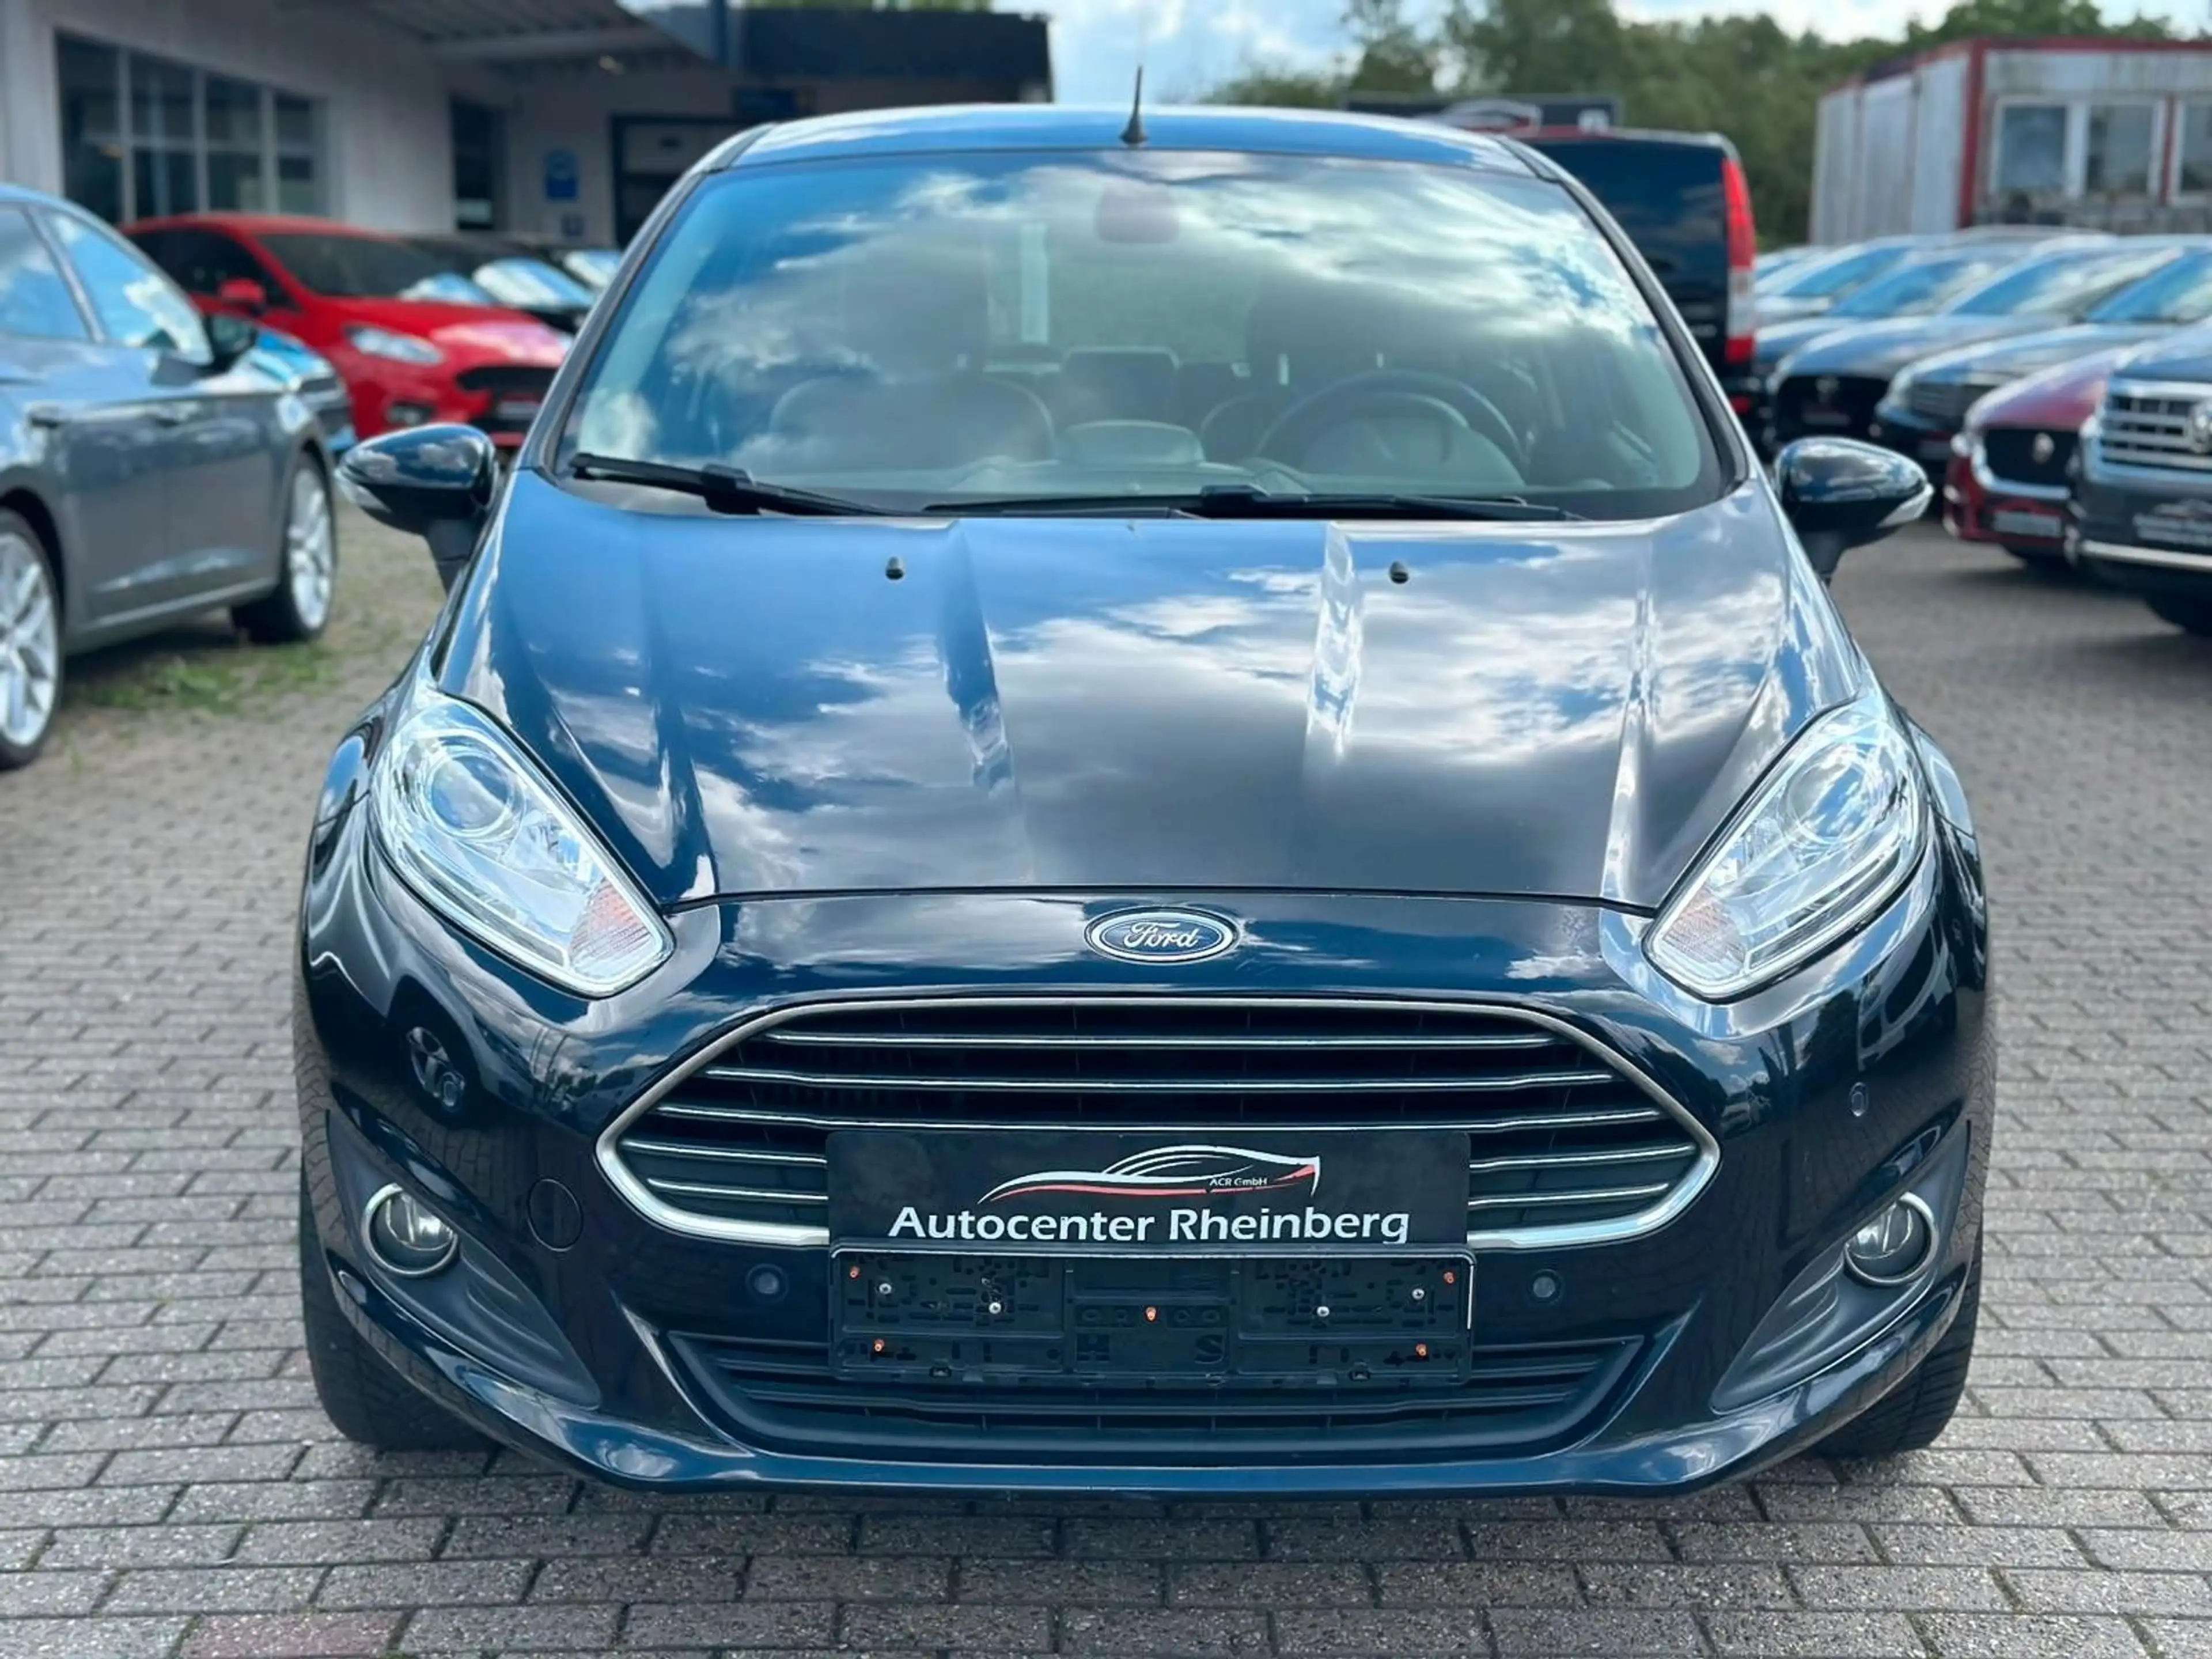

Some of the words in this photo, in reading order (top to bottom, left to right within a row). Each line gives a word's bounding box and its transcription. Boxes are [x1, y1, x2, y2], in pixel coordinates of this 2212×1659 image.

[1123, 922, 1200, 948] Ford
[1210, 1177, 1232, 1186] ACR
[1234, 1177, 1267, 1186] GmbH
[888, 1206, 1155, 1241] Autocenter
[1168, 1206, 1410, 1244] Rheinberg
